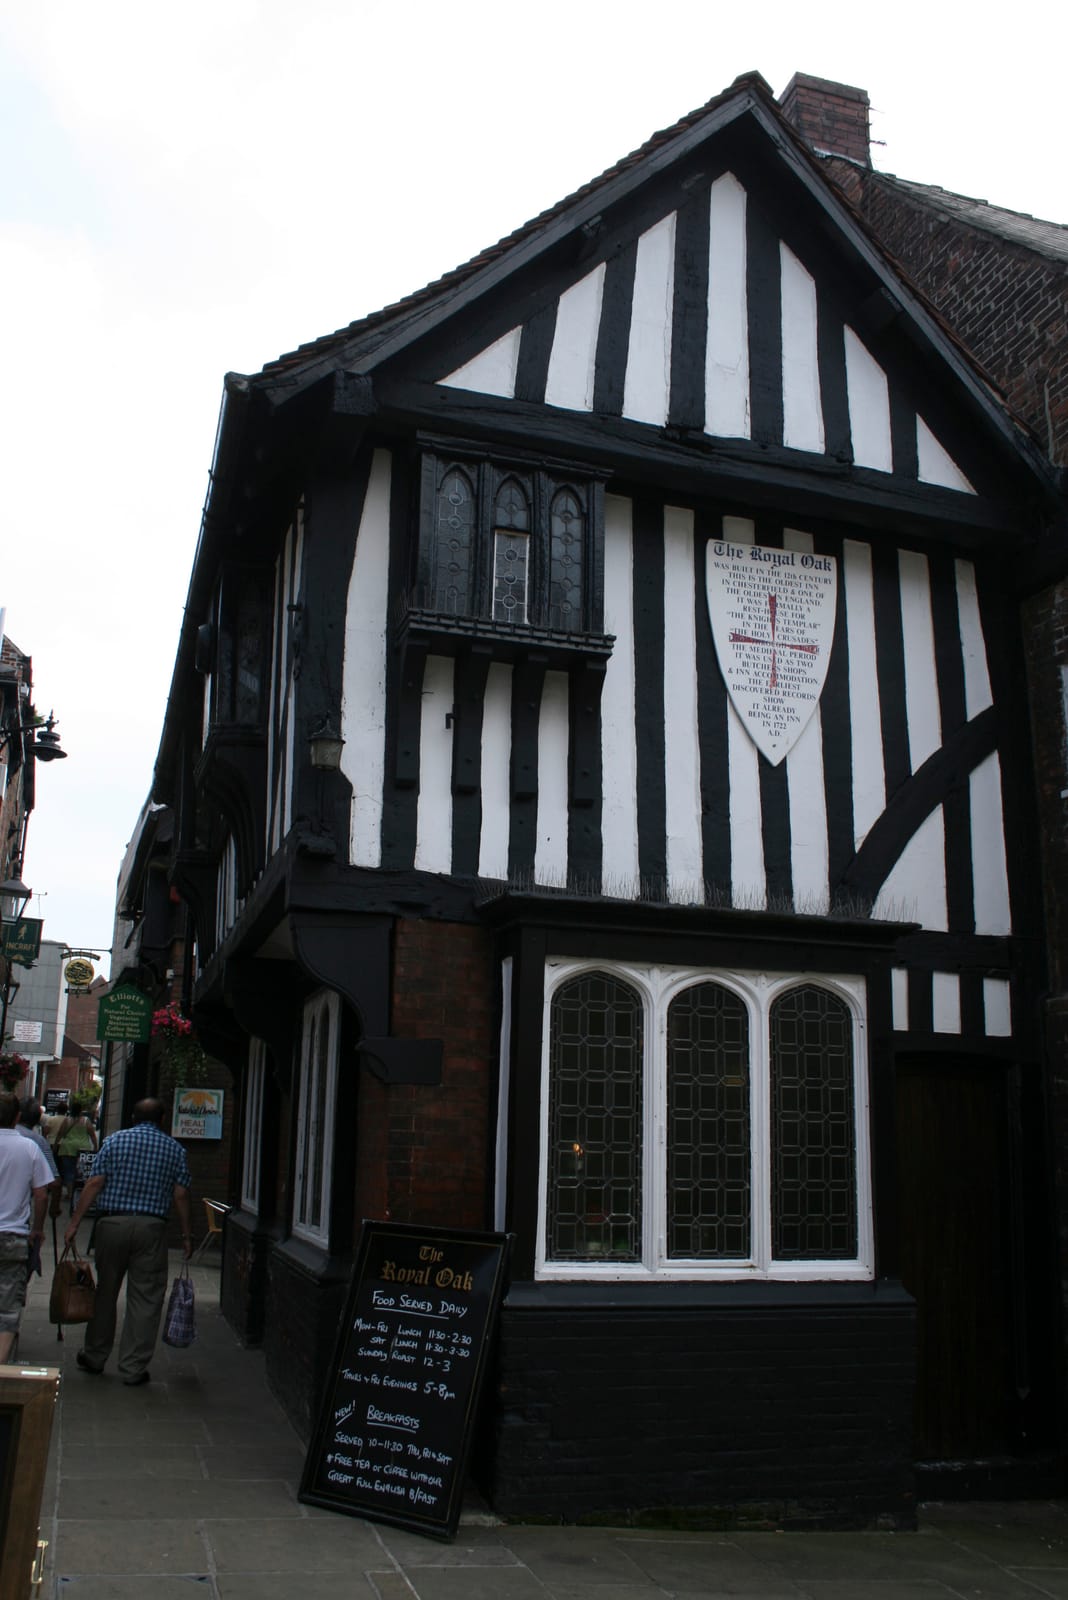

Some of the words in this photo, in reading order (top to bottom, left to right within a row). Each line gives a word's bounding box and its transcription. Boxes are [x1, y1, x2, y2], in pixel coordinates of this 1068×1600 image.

[714, 541, 744, 560] The
[750, 546, 796, 569] Royal
[800, 554, 832, 572] Oak
[714, 562, 729, 570] WAS
[732, 564, 753, 574] BUILT
[767, 569, 780, 577] THE
[784, 572, 796, 580] 12th
[799, 574, 831, 585] CENTURY
[729, 572, 746, 580] THIS
[759, 576, 771, 584] THE
[775, 578, 802, 588] OLDEST
[805, 582, 819, 590] INN
[727, 587, 739, 595] THE
[743, 590, 772, 600] OLDES
[732, 580, 788, 594] CHESTERFIELD
[798, 589, 812, 598] ONE
[743, 605, 787, 618] REST-HUSE
[791, 612, 805, 620] FOR
[747, 598, 762, 606] WAS
[765, 600, 803, 612] FRMALLY
[748, 614, 781, 625] KNIGHS
[751, 631, 770, 640] HOLY
[754, 623, 768, 631] THE
[771, 625, 794, 634] EARS
[732, 644, 745, 652] THE
[789, 651, 817, 661] PERIOD
[745, 653, 760, 662] WAS
[763, 656, 783, 664] USD
[797, 660, 813, 668] TWO
[736, 668, 750, 677] INN
[742, 661, 781, 672] BUTCHES
[784, 666, 807, 676] SHOPS
[748, 678, 762, 686] THE
[766, 680, 801, 691] ERLIEST
[732, 684, 780, 696] DISCOVERED
[783, 690, 817, 701] RECORDS
[763, 696, 785, 705] SHOW
[763, 704, 796, 714] ALREADY
[748, 711, 771, 720] BEING
[787, 716, 801, 724] INN
[774, 721, 787, 729] 1722
[418, 1245, 444, 1263] The
[381, 1260, 432, 1287] Royal
[434, 1267, 473, 1290] Oak
[372, 1290, 396, 1304] FOOD
[400, 1294, 433, 1312] SERVED
[398, 1324, 422, 1338] LUNCH
[370, 1336, 388, 1345] SAT
[394, 1338, 418, 1350] LUNCH
[390, 1350, 416, 1363] ROAST
[370, 1374, 380, 1385] FRI
[383, 1376, 418, 1392] EVENINGS
[366, 1404, 420, 1430] BREAKFASTS
[334, 1431, 362, 1447] SERVED
[436, 1452, 453, 1466] SAT
[334, 1452, 352, 1467] FREE
[354, 1459, 370, 1470] TEA
[328, 1470, 354, 1484] GREAT
[356, 1476, 373, 1489] FULL
[374, 1479, 406, 1496] ENGLISH
[408, 1486, 438, 1505] B/FAST
